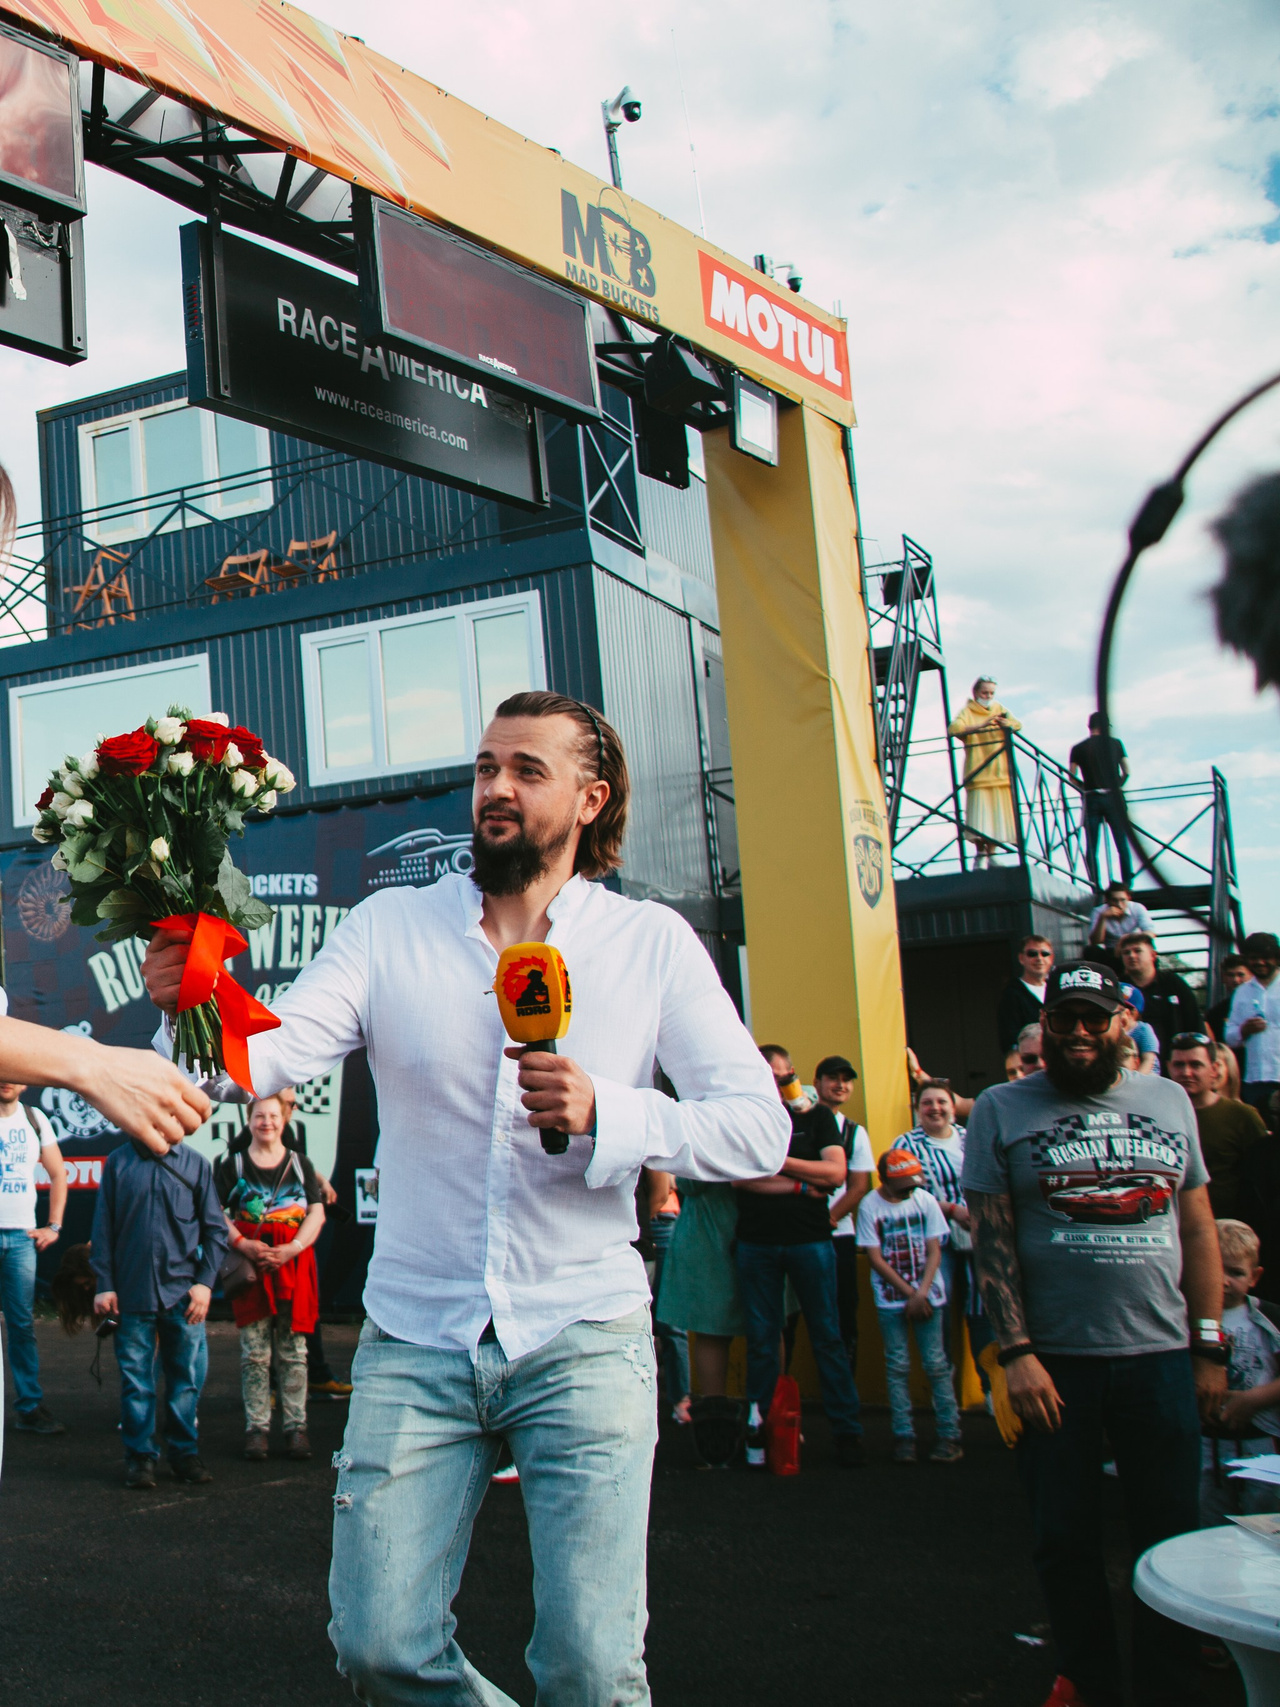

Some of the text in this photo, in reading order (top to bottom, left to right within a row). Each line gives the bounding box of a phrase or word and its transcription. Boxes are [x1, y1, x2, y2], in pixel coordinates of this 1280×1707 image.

[565, 261, 660, 324] MAD BUCKETS
[710, 270, 843, 388] MOTUL
[314, 383, 469, 452] www.raceamerica.com
[9, 1128, 27, 1143] GO
[1047, 1138, 1177, 1167] RUSSIAN WEEKEND
[1098, 1160, 1133, 1168] DRAGS
[2, 1182, 27, 1193] FLOW
